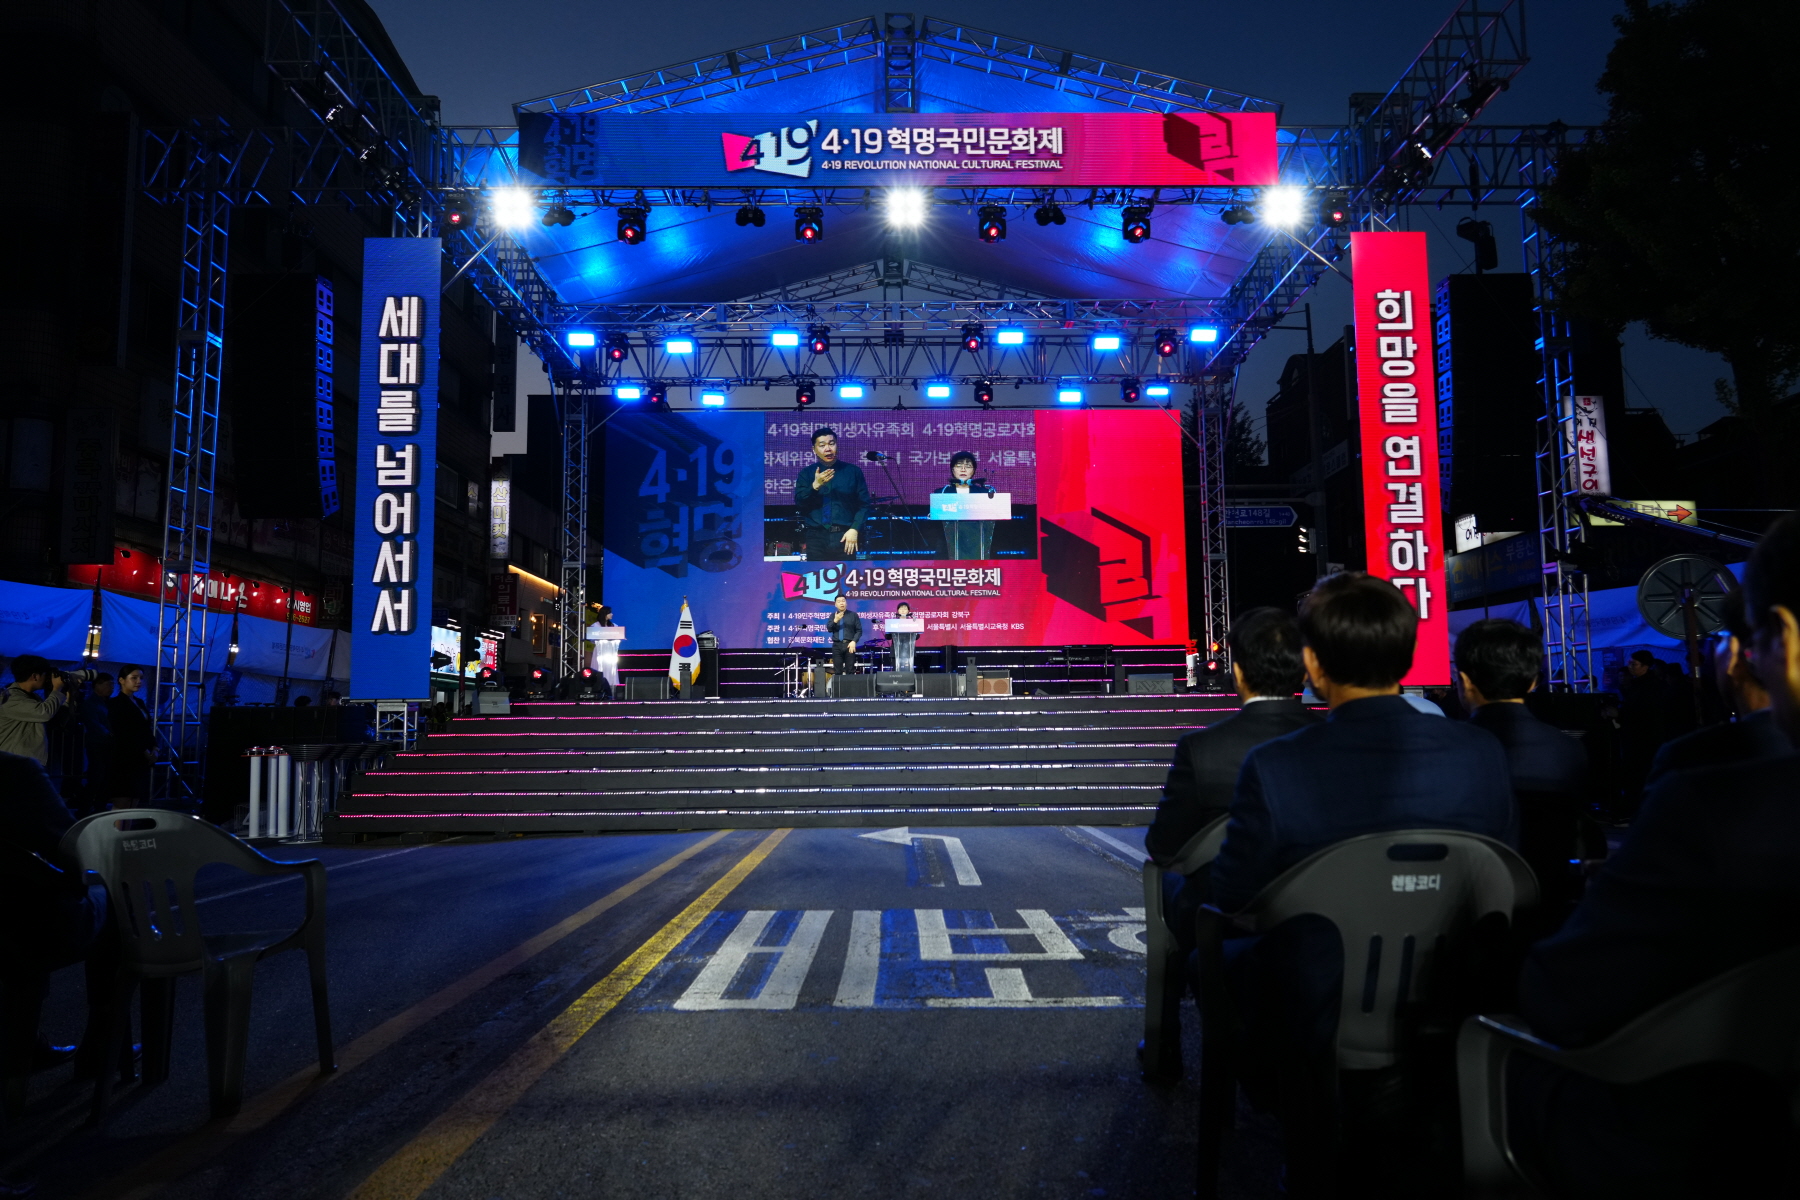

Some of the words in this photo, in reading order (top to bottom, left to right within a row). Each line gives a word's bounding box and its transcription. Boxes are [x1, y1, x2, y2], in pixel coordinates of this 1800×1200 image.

[821, 128, 883, 154] 4·19
[887, 127, 1063, 155] 혁명국민문화제
[845, 160, 907, 170] REVOLUTION
[909, 160, 960, 169] NATIONAL
[962, 160, 1013, 169] CULTURAL
[1015, 160, 1063, 169] FESTIVAL
[377, 296, 422, 432] 세대를
[1376, 288, 1419, 423] 희망을
[1577, 429, 1599, 491] 생선구이
[370, 445, 417, 632] 넘어서서
[1386, 435, 1432, 619] 연결하다
[1505, 537, 1535, 561] 부동산
[845, 569, 885, 586] 4·19
[888, 568, 1001, 586] 혁명국민문화제
[286, 598, 312, 614] 2시영업
[498, 584, 510, 615] 의료기
[767, 612, 780, 620] 주최
[951, 611, 970, 620] 강북구
[767, 624, 780, 632] 주관
[960, 623, 1009, 631] 서울특별시교육청
[767, 636, 780, 644] 협찬
[1391, 873, 1441, 893] 렌탈코디
